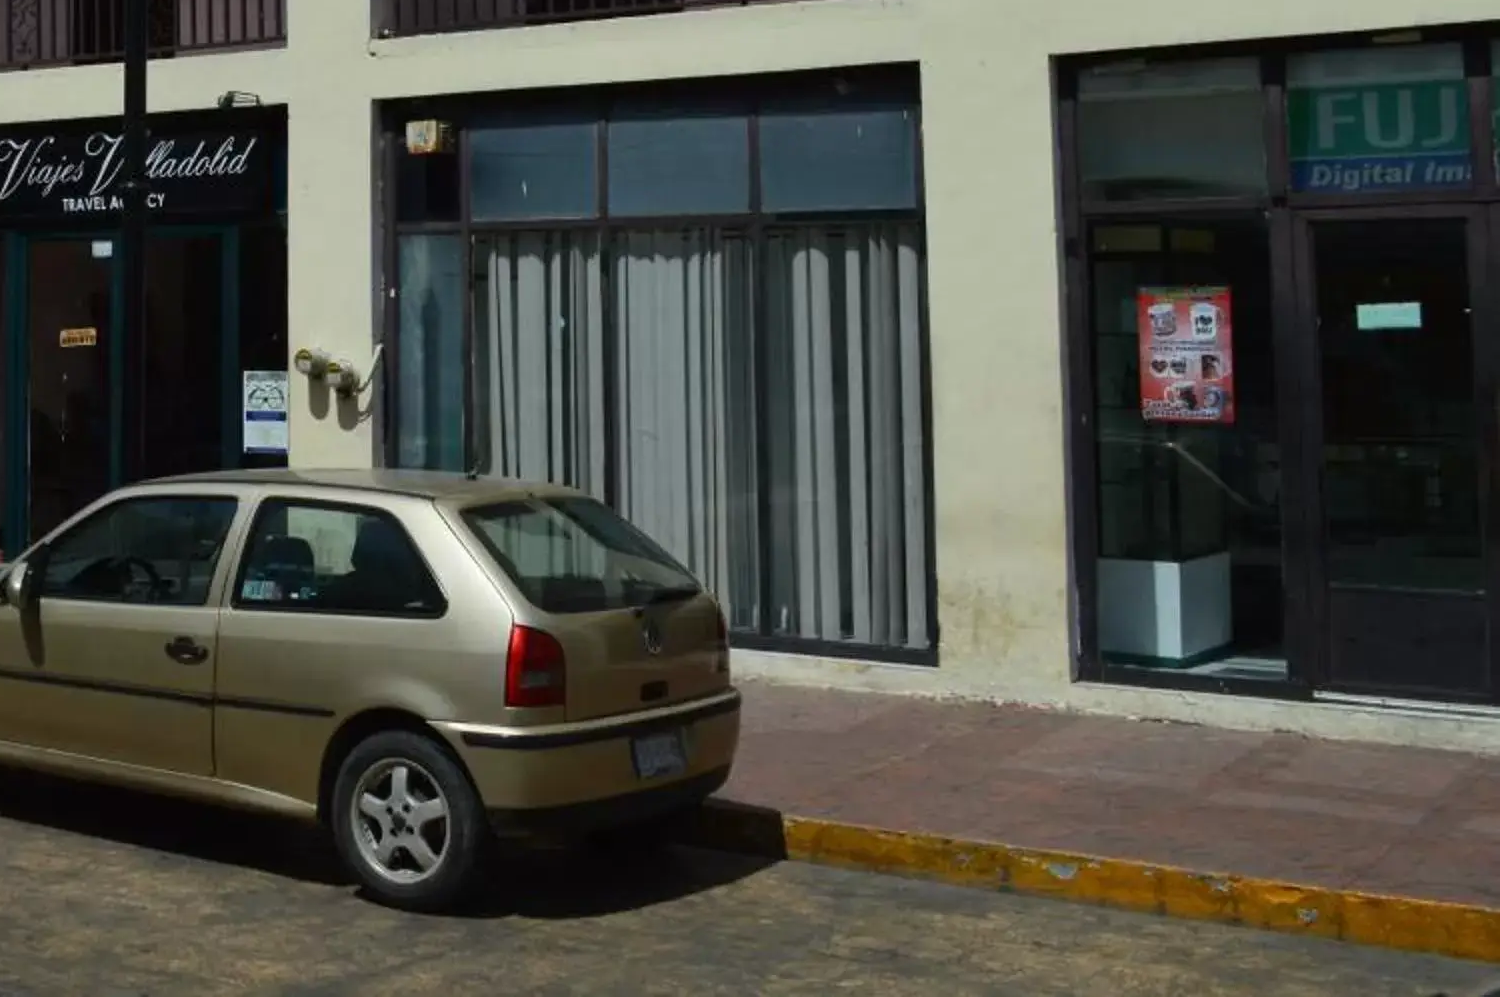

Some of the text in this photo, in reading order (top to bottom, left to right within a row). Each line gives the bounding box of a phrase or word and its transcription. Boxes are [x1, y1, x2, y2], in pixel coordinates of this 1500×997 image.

[84, 131, 257, 196] Vlladolid
[1310, 160, 1472, 190] Digital Im
[62, 193, 166, 212] TRAVEL ACY
